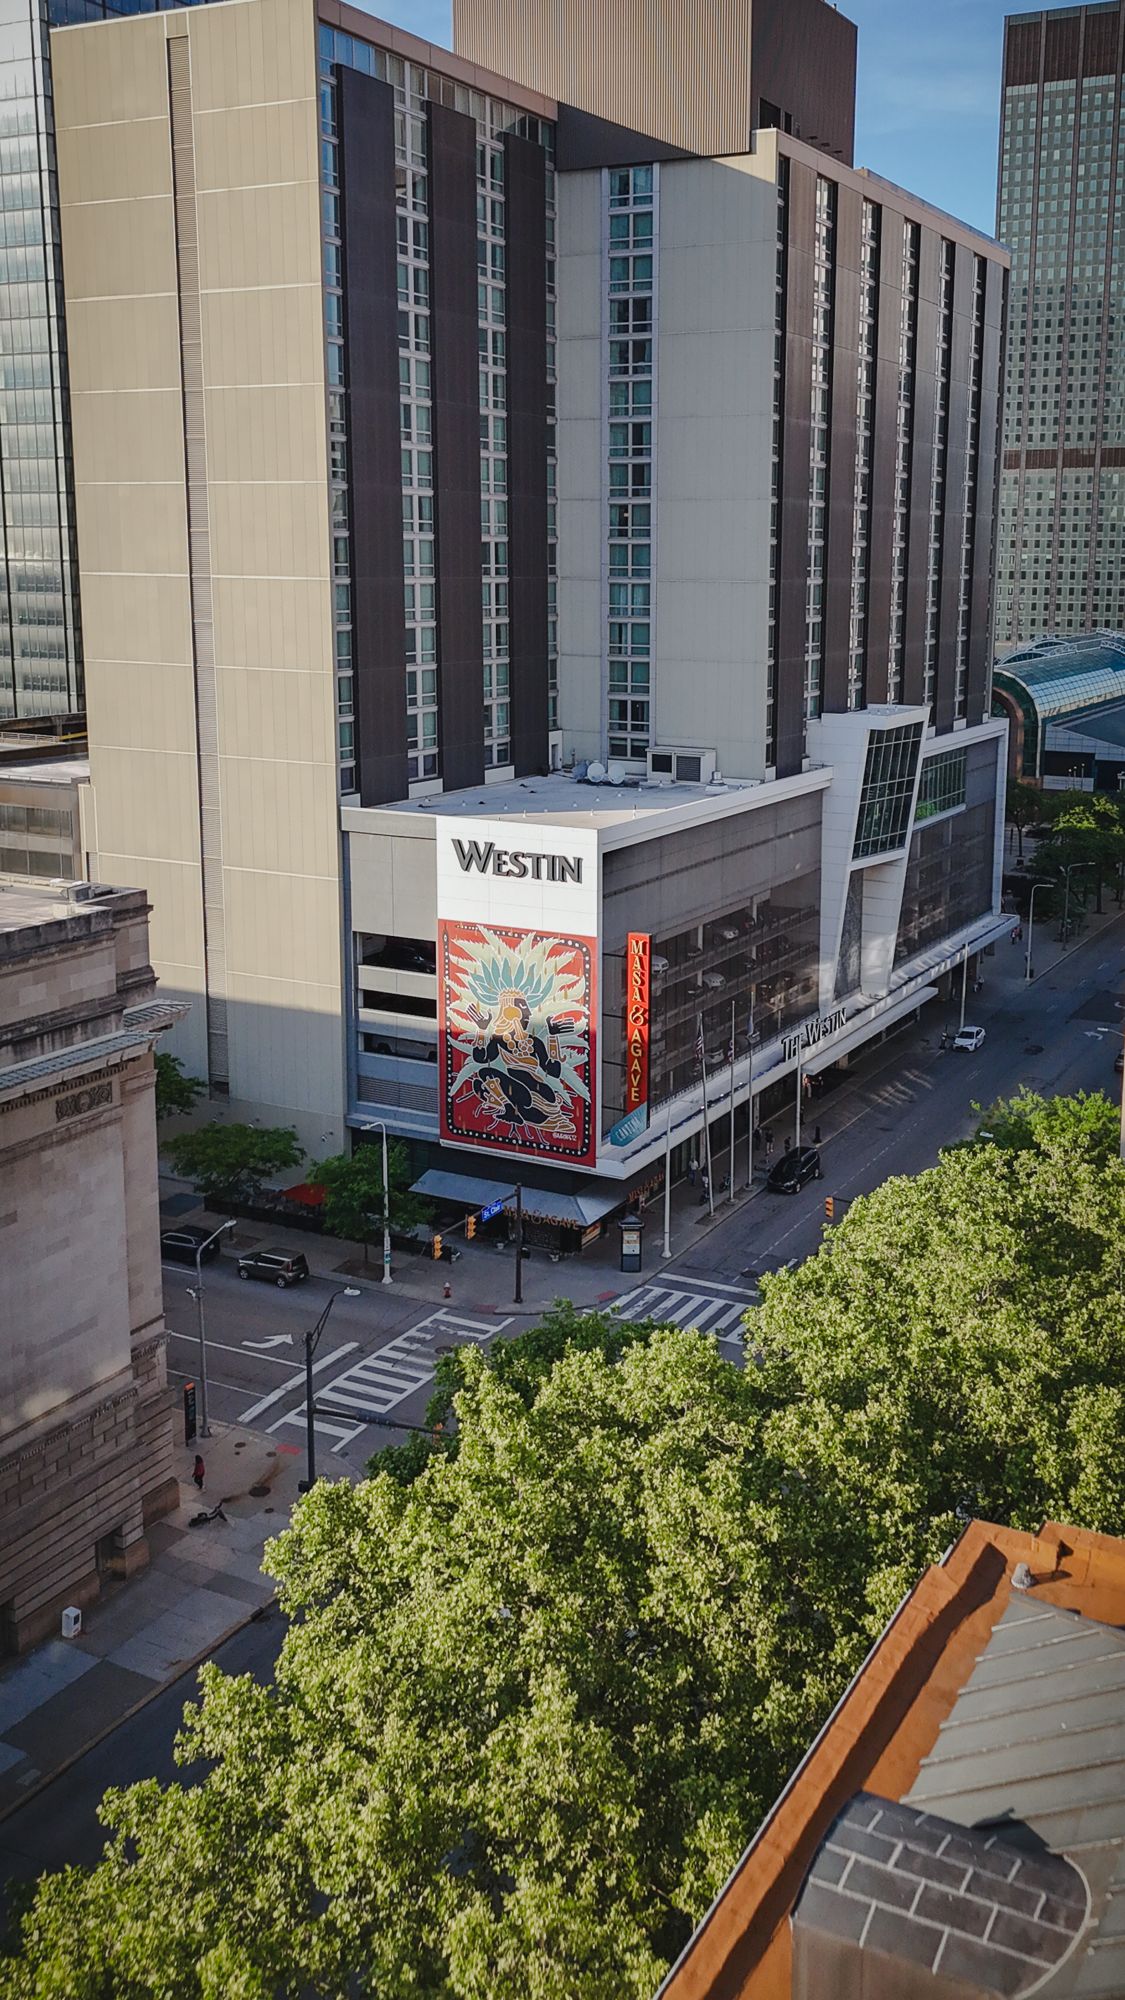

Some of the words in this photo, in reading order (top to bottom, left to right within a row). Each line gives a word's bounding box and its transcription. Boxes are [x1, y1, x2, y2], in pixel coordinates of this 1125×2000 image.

[451, 838, 584, 884] WESTIN
[630, 938, 645, 1003] MASA
[629, 1004, 644, 1026] &
[805, 1007, 847, 1045] WESTIN
[631, 1028, 642, 1102] AGAVE
[543, 1213, 580, 1230] AGAVE
